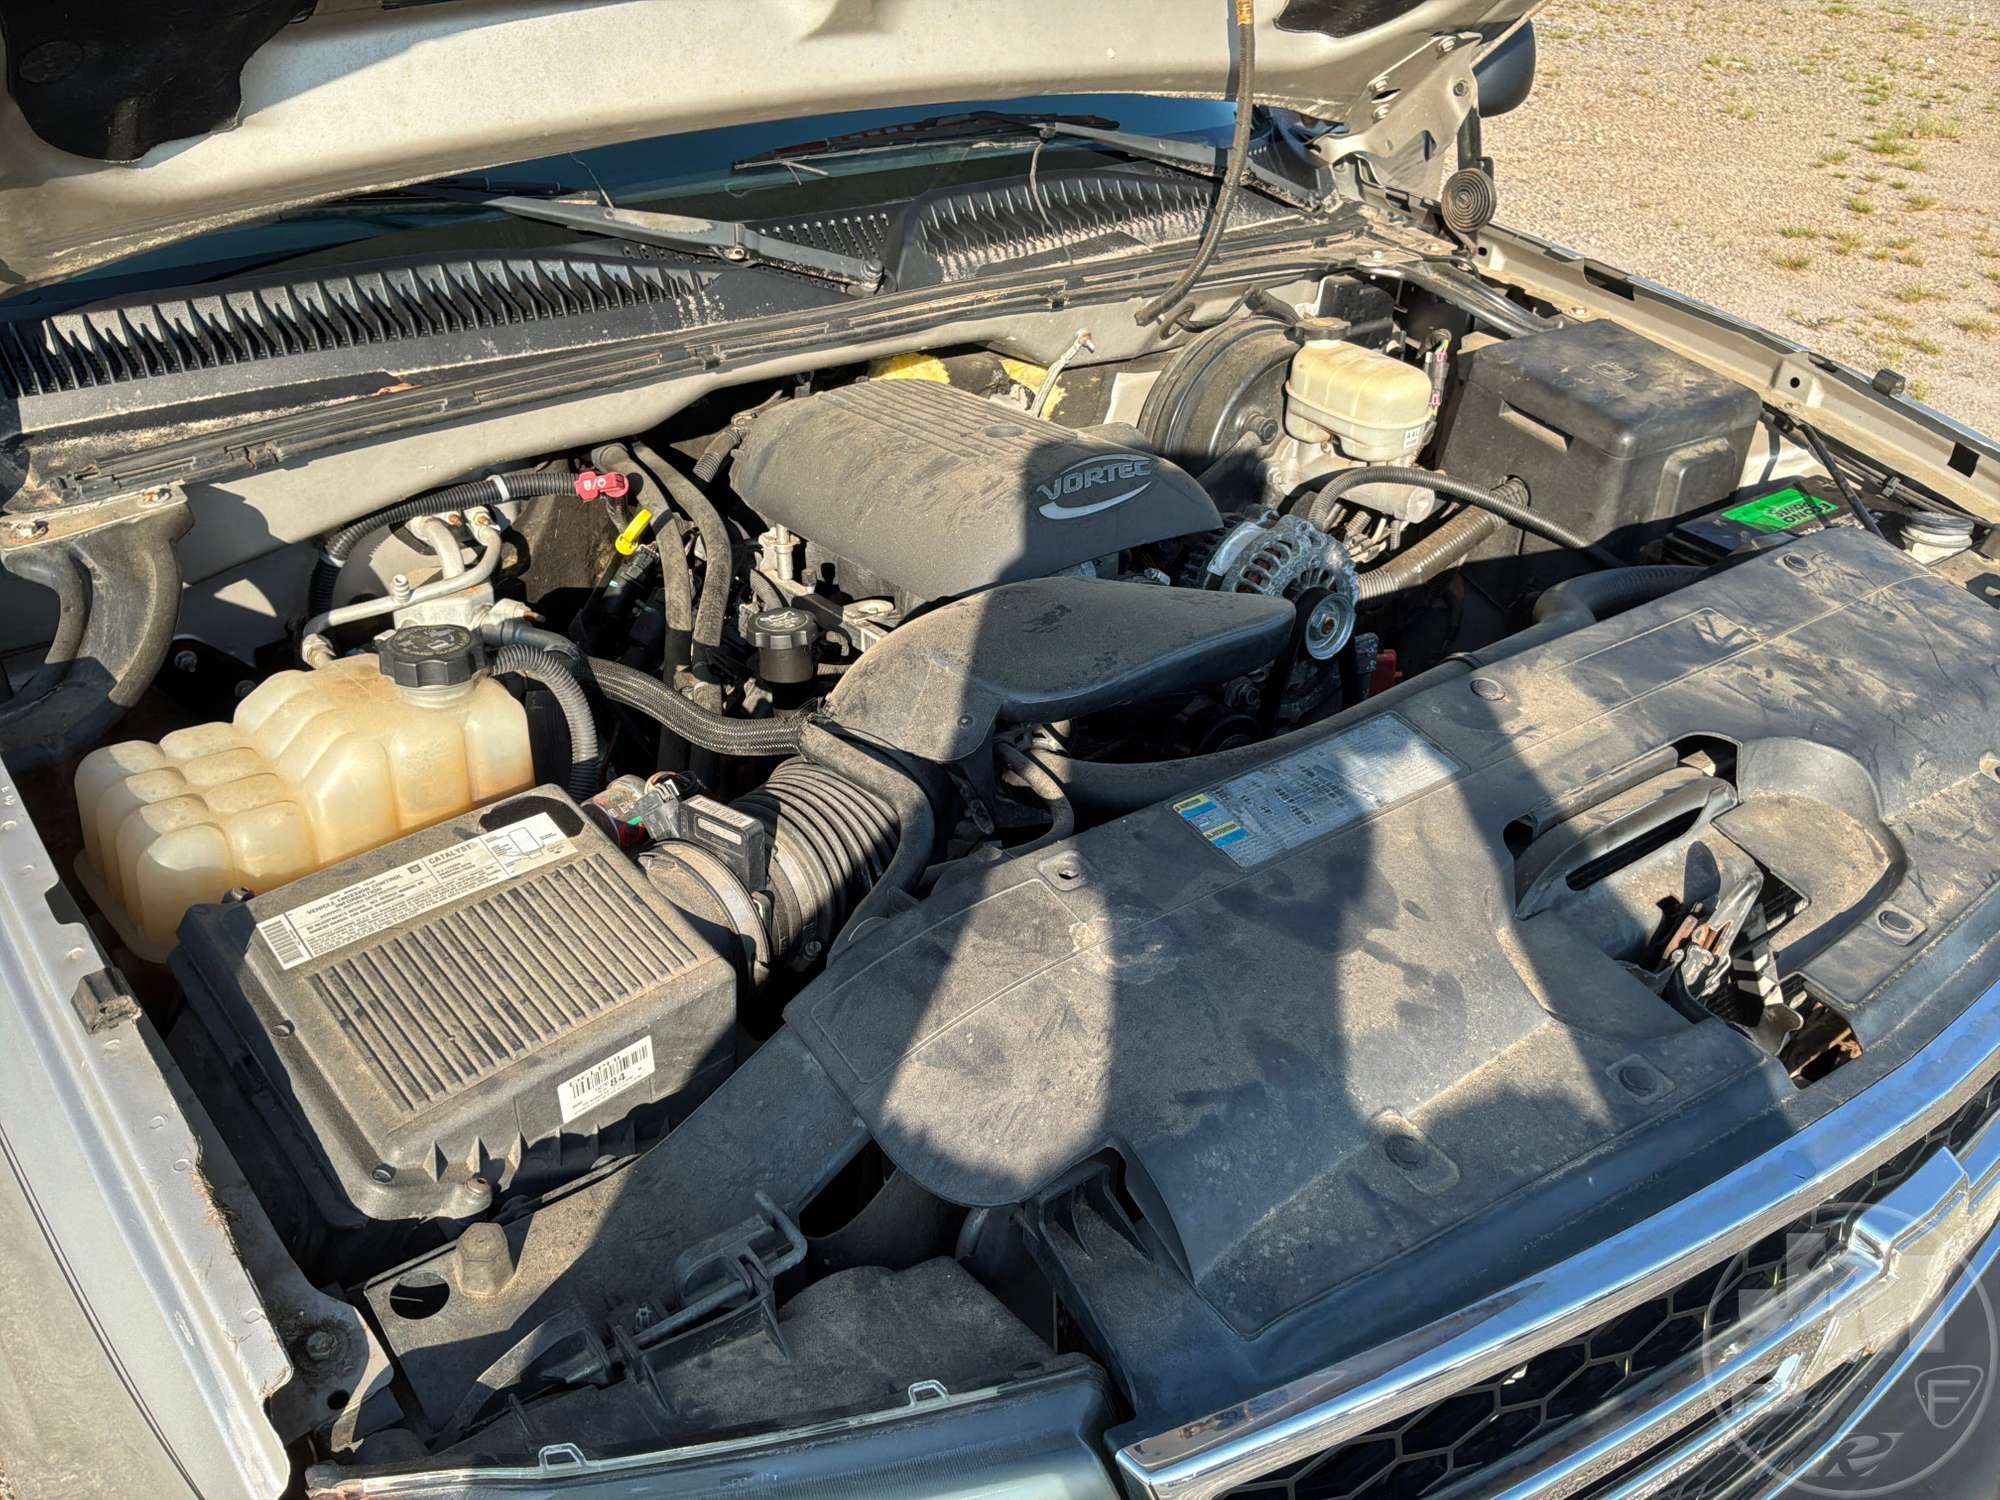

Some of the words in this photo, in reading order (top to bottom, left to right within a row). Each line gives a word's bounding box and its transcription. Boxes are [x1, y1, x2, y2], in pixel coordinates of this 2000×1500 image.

[1036, 460, 1152, 500] VORTEC
[427, 843, 472, 864] CATALYST
[610, 1072, 626, 1087] 84
